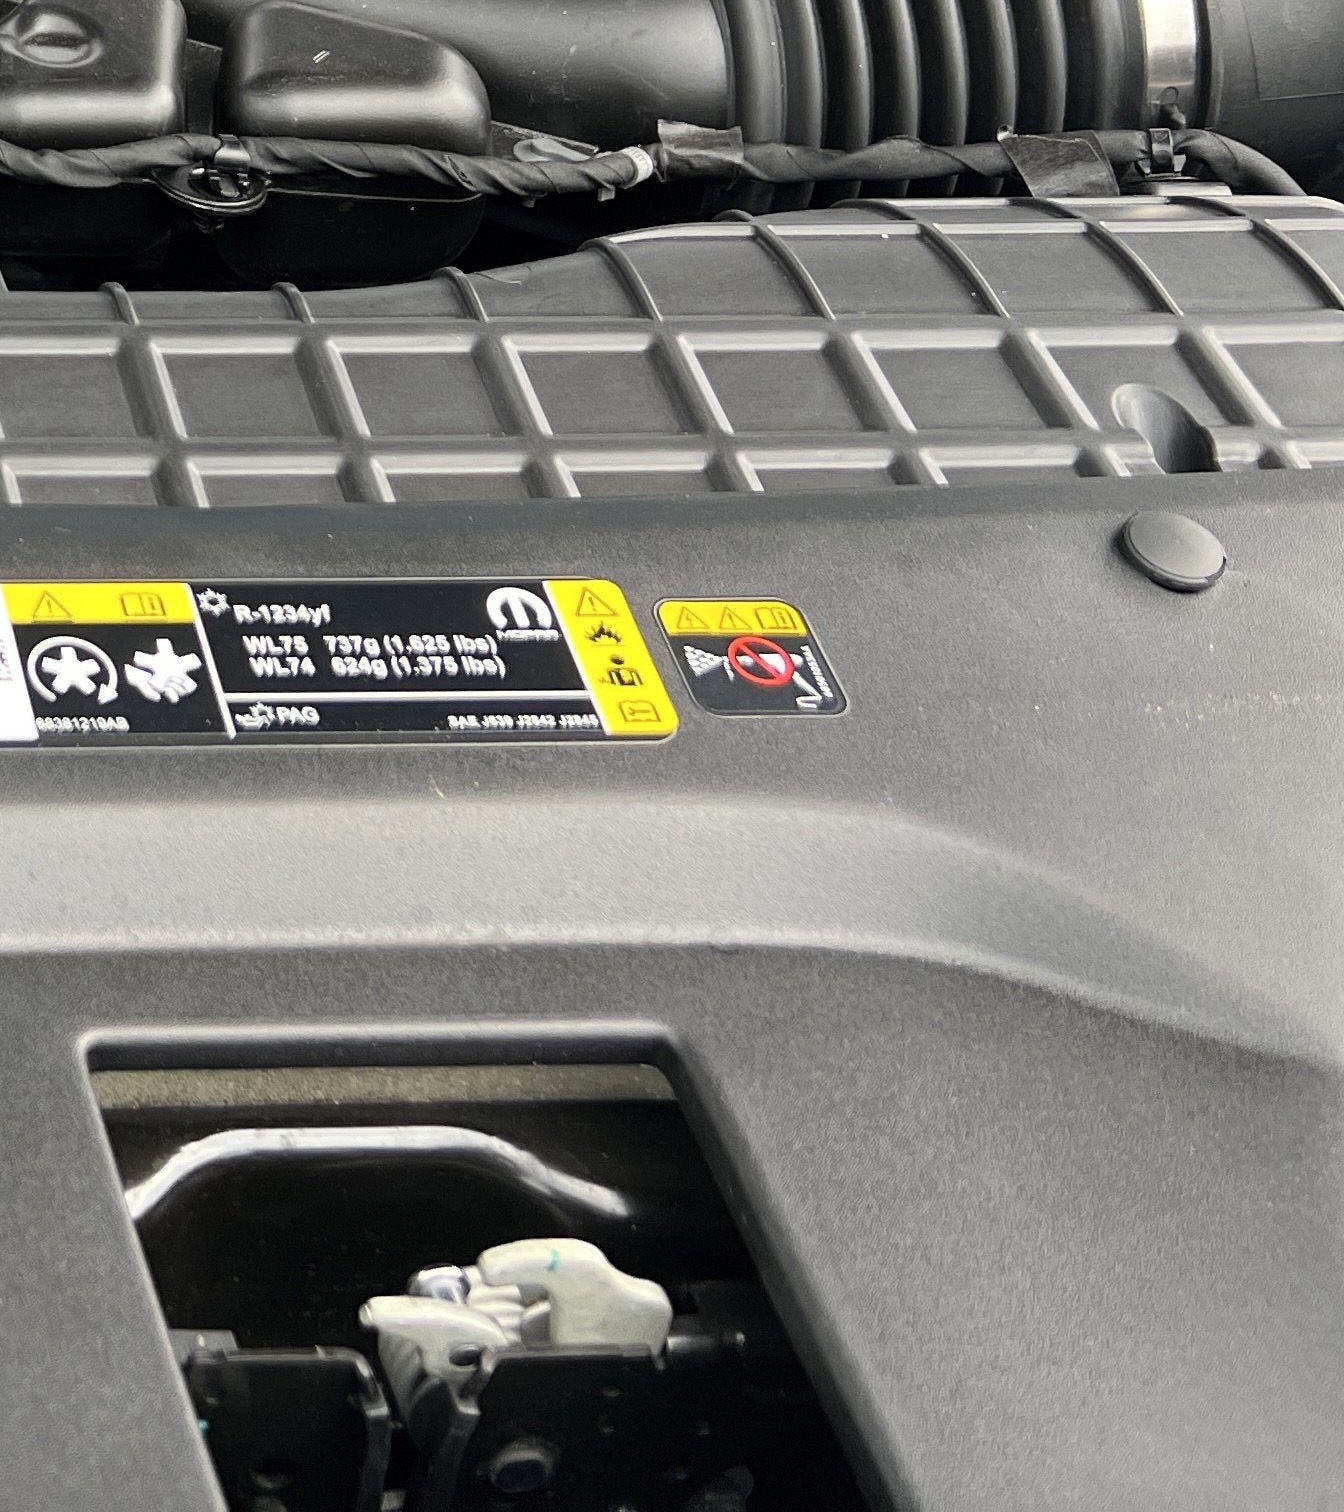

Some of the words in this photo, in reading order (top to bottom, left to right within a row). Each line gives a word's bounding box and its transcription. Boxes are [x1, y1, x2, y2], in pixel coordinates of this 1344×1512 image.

[232, 603, 331, 629] R-1234yf
[243, 634, 308, 656] WL75
[322, 634, 380, 658] 737g
[453, 634, 498, 657] lbs)
[249, 656, 316, 678] WL74
[330, 656, 389, 680] 624g
[462, 656, 506, 680] lbs)
[276, 706, 320, 728] PAG
